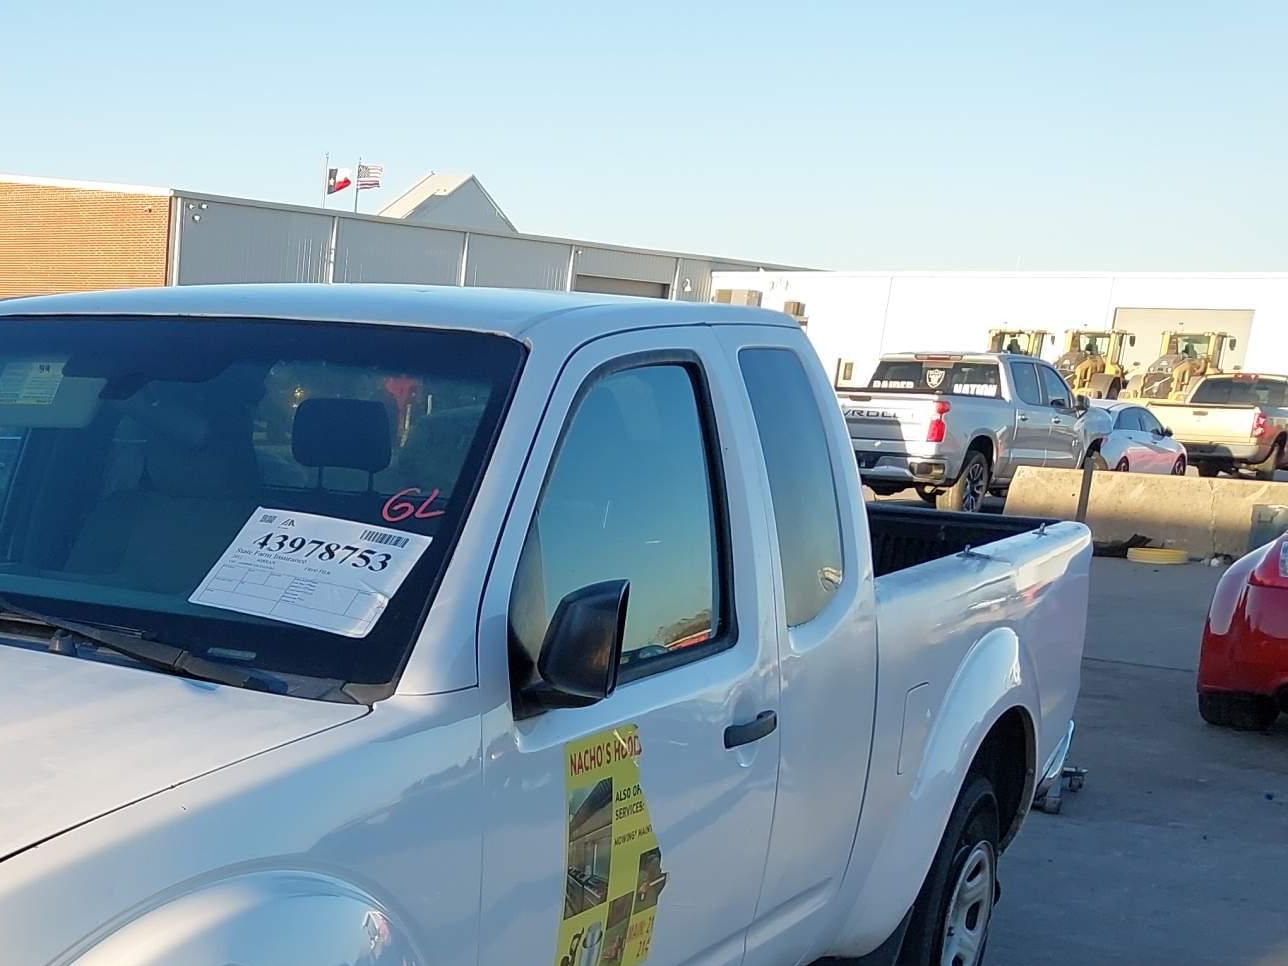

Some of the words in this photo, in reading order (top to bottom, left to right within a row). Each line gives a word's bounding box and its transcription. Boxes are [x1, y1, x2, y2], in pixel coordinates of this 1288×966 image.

[953, 383, 998, 397] NATION
[253, 532, 393, 573] 43978753
[570, 743, 612, 777] NACHO'S
[615, 787, 631, 801] ALSO
